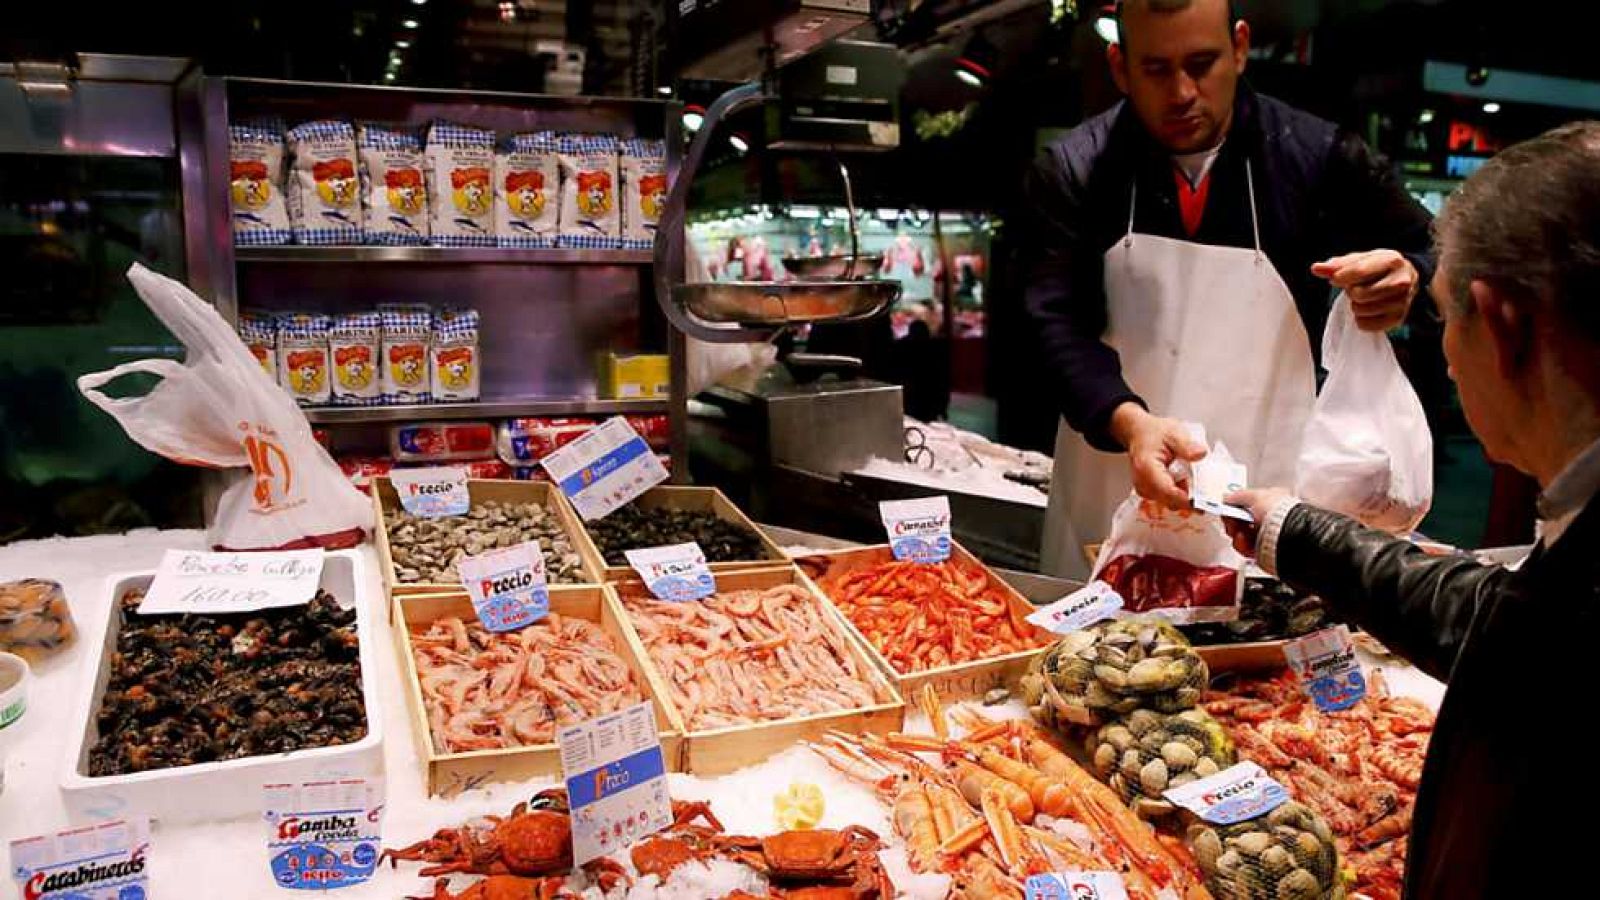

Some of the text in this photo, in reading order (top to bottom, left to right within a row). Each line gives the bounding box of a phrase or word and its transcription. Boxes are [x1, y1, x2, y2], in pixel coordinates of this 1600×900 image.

[409, 480, 453, 496] Precio
[480, 570, 532, 597] Precio
[1203, 779, 1255, 805] Precio
[278, 815, 356, 839] Gamba
[25, 858, 146, 900] Carabineros
